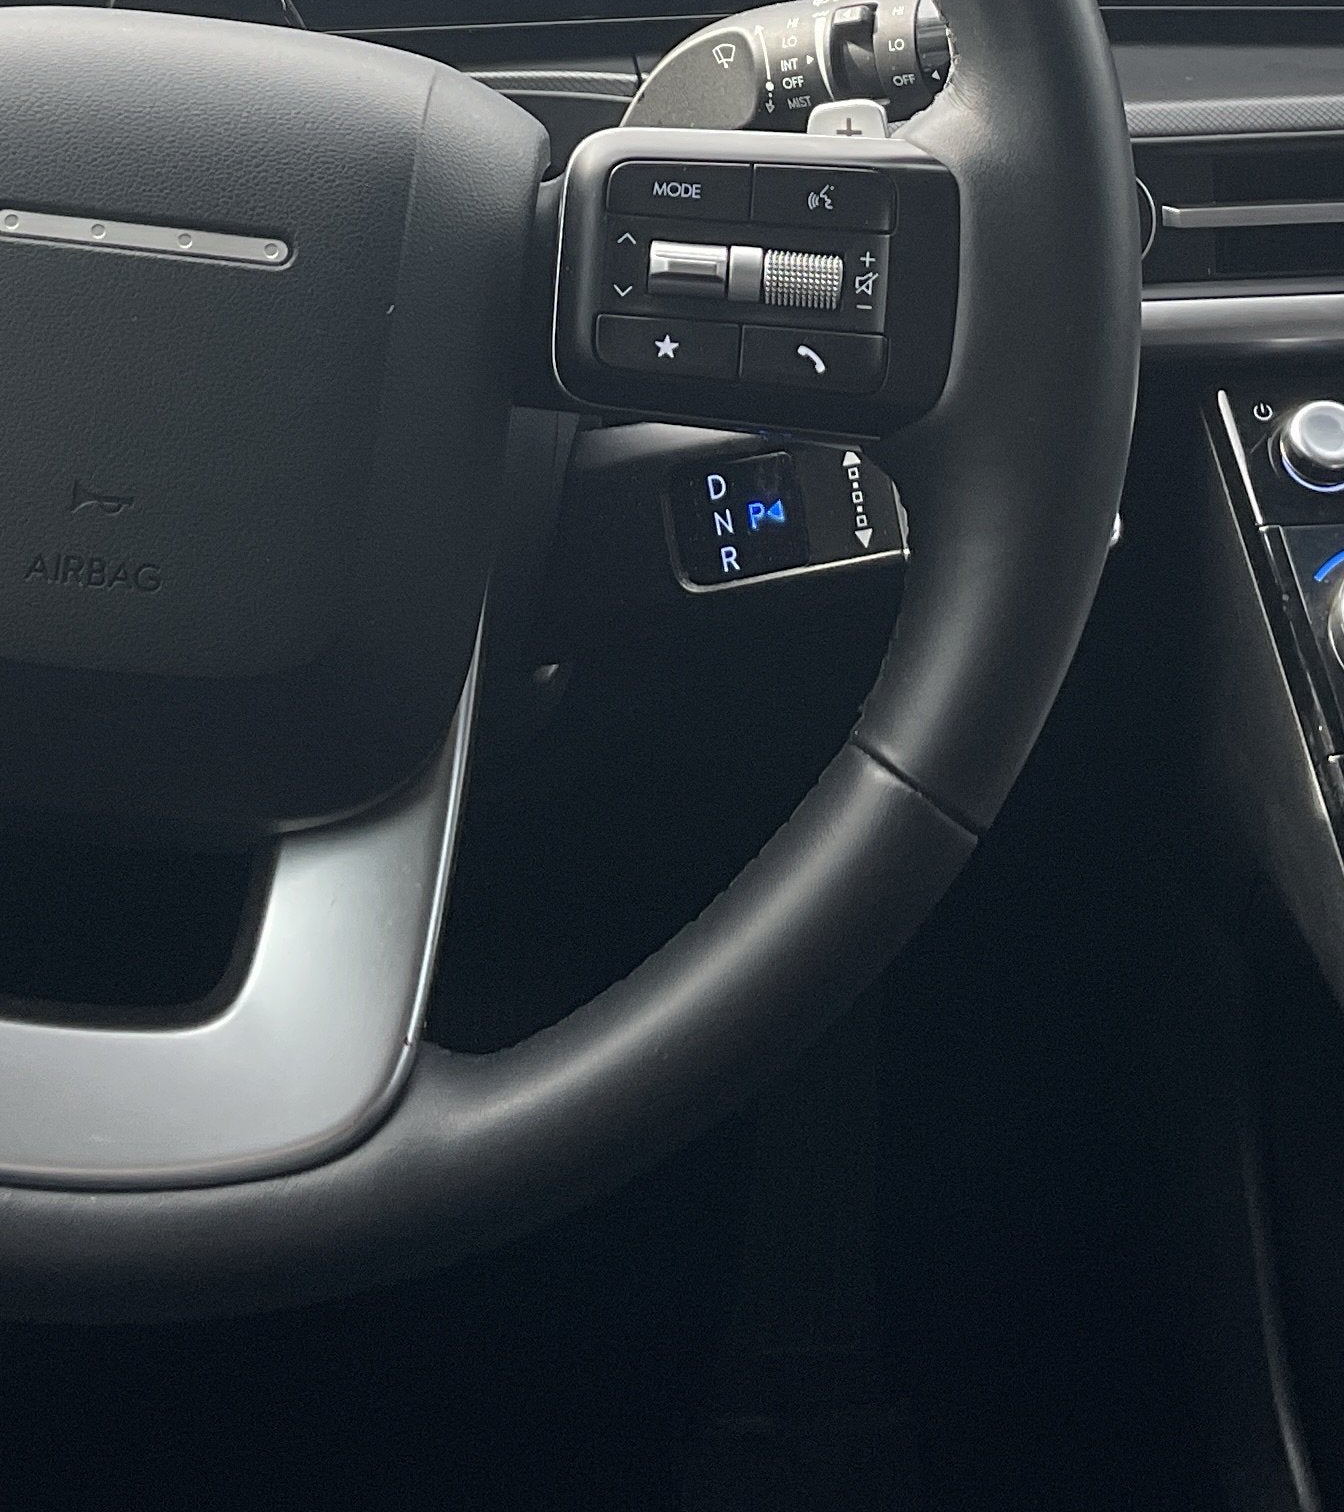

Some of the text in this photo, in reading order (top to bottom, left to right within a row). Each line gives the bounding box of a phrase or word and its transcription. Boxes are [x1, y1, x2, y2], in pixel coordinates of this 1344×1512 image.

[781, 36, 797, 49] LO
[888, 39, 905, 52] LO
[780, 58, 799, 72] INT
[782, 76, 804, 90] OFF
[892, 73, 915, 88] OFF
[787, 95, 812, 110] MIST
[652, 181, 702, 200] MODE
[707, 474, 727, 501] D
[714, 508, 735, 537] N
[748, 502, 765, 531] P
[720, 546, 741, 573] R
[24, 553, 163, 593] AIRBAG
